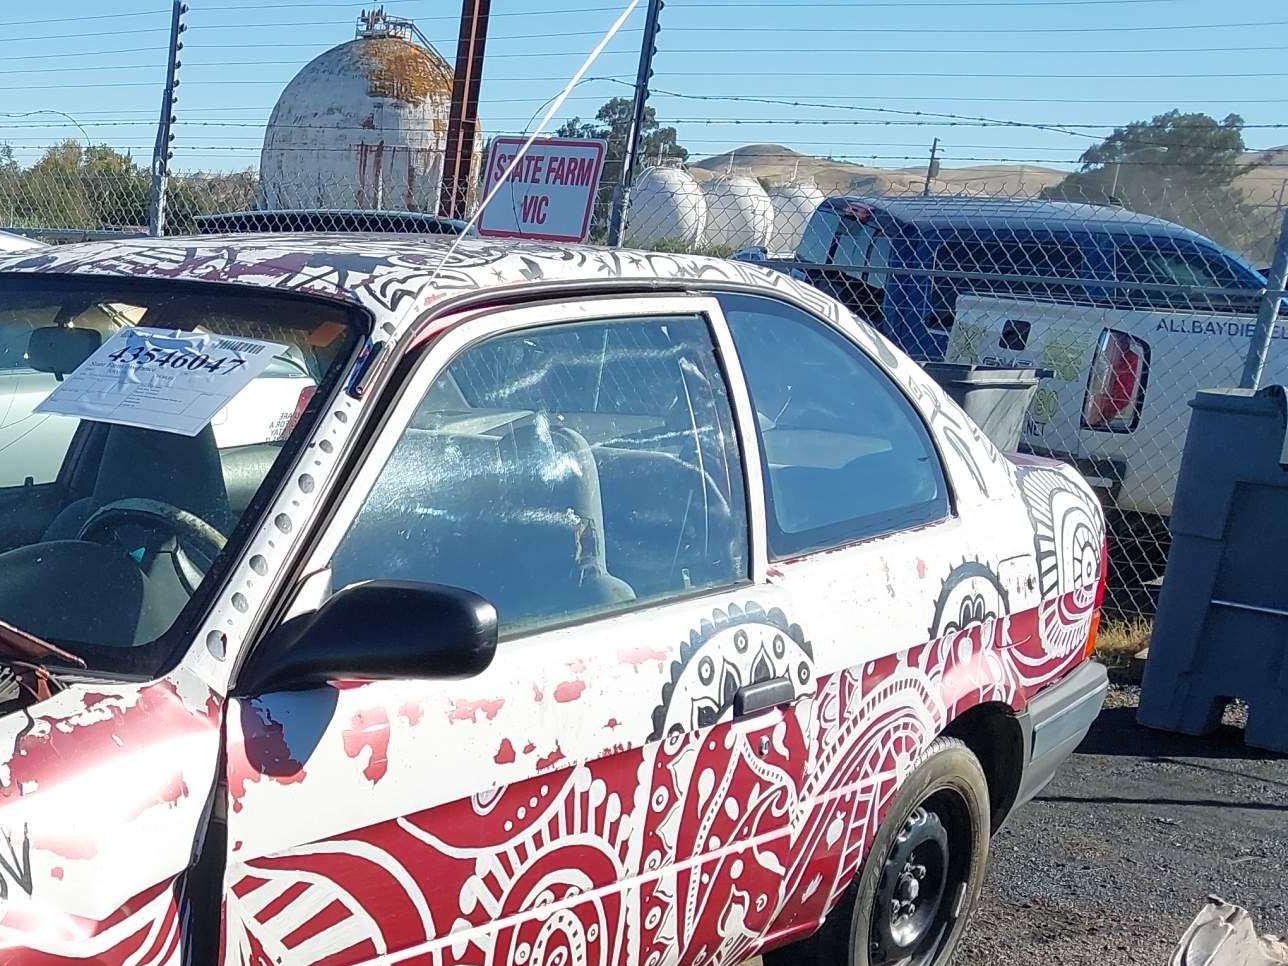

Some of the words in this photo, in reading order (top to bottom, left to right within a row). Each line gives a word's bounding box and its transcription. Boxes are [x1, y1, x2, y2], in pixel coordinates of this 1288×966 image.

[494, 154, 544, 184] STATE
[545, 157, 594, 186] FARM
[522, 195, 549, 224] VIC
[108, 346, 247, 376] 43546047
